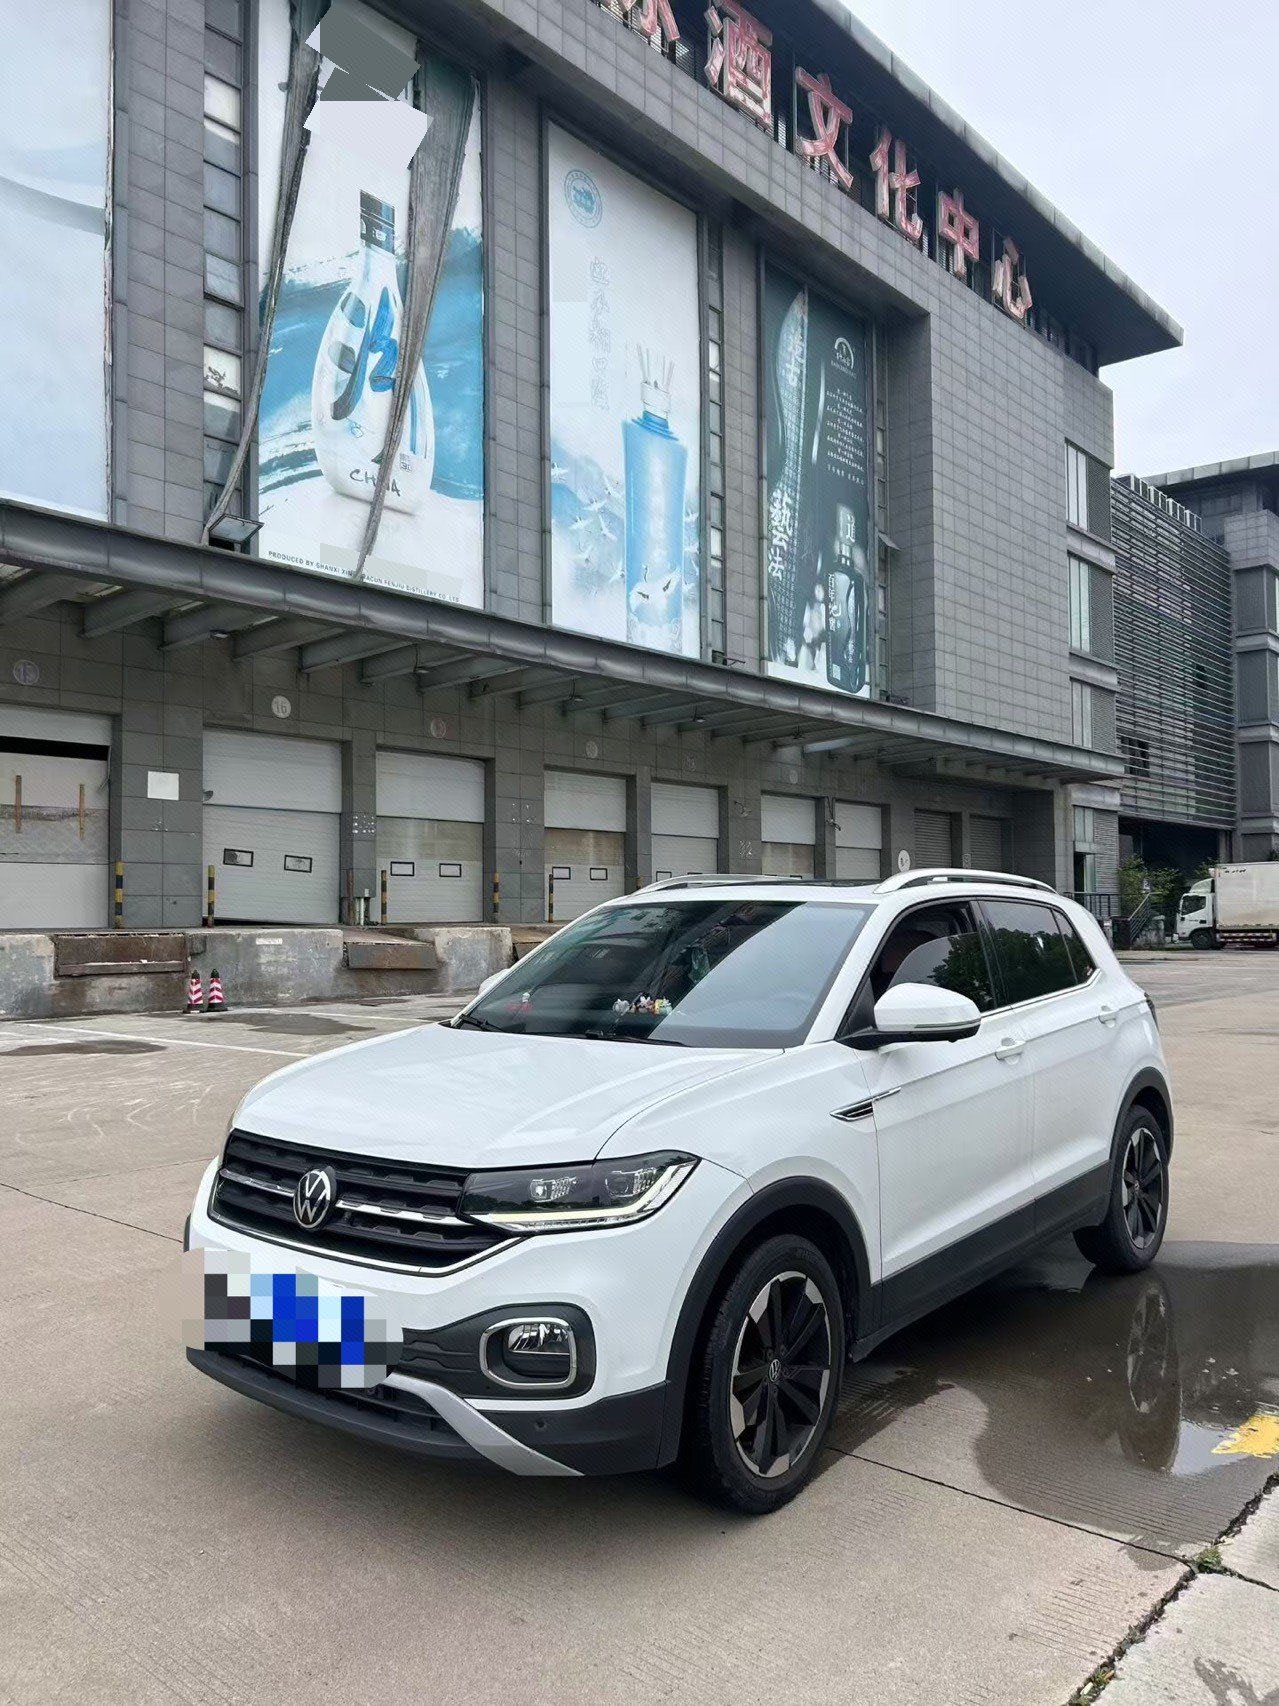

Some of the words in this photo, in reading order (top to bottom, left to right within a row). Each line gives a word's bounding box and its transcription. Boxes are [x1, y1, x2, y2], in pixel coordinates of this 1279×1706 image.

[349, 468, 401, 497] CHA
[268, 550, 304, 565] PRODUCED
[316, 562, 340, 573] SHANXI
[274, 698, 288, 715] 16
